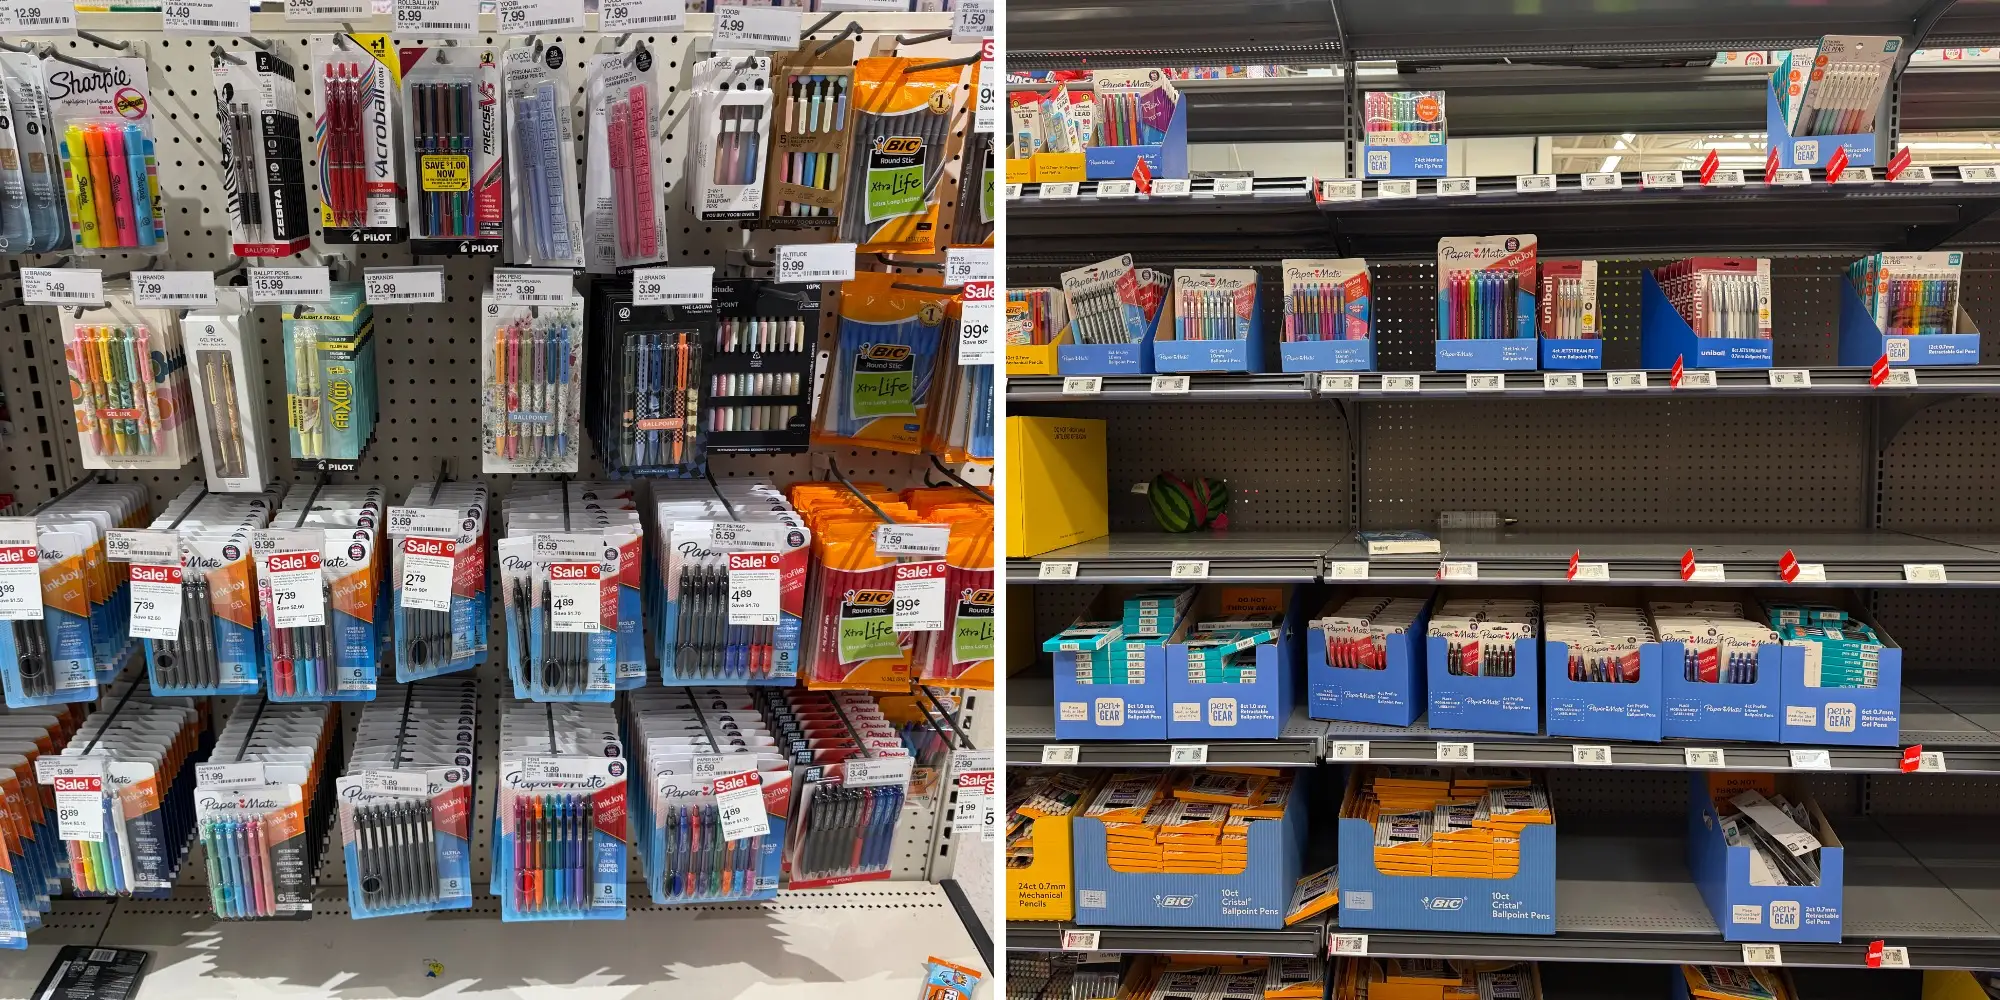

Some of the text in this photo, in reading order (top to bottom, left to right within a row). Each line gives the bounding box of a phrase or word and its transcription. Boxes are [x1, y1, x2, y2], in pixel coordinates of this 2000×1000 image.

[15, 8, 41, 18] 12.99
[166, 6, 190, 18] 4.49
[502, 11, 525, 22] 7.99
[604, 8, 628, 19] 7.99
[962, 14, 985, 25] 1.59
[720, 20, 744, 32] 4.99
[371, 37, 385, 48] +1
[49, 66, 132, 100] Sharpie
[1099, 79, 1126, 89] Paper
[372, 88, 388, 178] Acroball
[483, 105, 491, 154] PRECISE
[901, 156, 915, 164] Stic
[1369, 153, 1388, 162] pen+
[1797, 151, 1814, 160] GEAR
[425, 161, 466, 170] SAVE $1.00
[1372, 161, 1387, 170] GEAR
[436, 170, 456, 178] NOW
[892, 172, 922, 195] Life
[276, 188, 287, 236] ZEBRA
[364, 234, 392, 242] PILOT
[244, 246, 280, 255] BALLPOINT
[471, 244, 499, 252] PILOT
[1442, 246, 1506, 260] Paper Mate
[1508, 250, 1534, 267] InkJoy
[782, 261, 804, 271] 9.99
[950, 266, 970, 275] 1.59
[1065, 269, 1123, 289] Paper Mate
[1287, 268, 1342, 280] Paper Mate
[46, 283, 65, 291] 5.49
[256, 280, 284, 290] 15.99
[1178, 275, 1242, 289] Paper Mate
[138, 284, 161, 294] 7.99
[369, 284, 396, 294] 12.99
[516, 286, 535, 294] 3.99
[639, 284, 661, 294] 3.99
[1544, 276, 1552, 324] uniball
[1694, 272, 1702, 318] uniball
[1890, 349, 1906, 357] GEAR
[879, 376, 910, 397] Life
[513, 414, 549, 422] BALLPOINT
[392, 518, 411, 526] 3.69
[716, 532, 735, 540] 6.59
[883, 536, 901, 544] 1.59
[109, 541, 129, 550] 9.99
[255, 541, 275, 549] 9.99
[406, 540, 442, 554] Sale!
[186, 557, 222, 568] Mate
[270, 556, 307, 570] Sale!
[731, 556, 766, 568] Sale!
[132, 568, 168, 581] Sale!
[553, 566, 587, 578] Sale!
[897, 567, 932, 579] Sale!
[44, 568, 84, 592] InkJoy
[212, 580, 245, 598] InkJoy
[335, 579, 368, 598] InkJoy
[64, 590, 80, 601] GEL
[231, 601, 246, 610] GEL
[865, 621, 893, 640] Life
[1324, 624, 1369, 634] Paper Mate
[1430, 628, 1454, 638] Paper
[1480, 630, 1505, 640] Paper
[1662, 633, 1718, 645] Paper Mate
[1725, 637, 1750, 648] Paper
[70, 661, 80, 670] 3
[1699, 655, 1716, 665] Profile
[234, 664, 243, 673] 6
[1097, 703, 1121, 713] pen+
[1211, 703, 1234, 713] pen+
[1827, 707, 1852, 718] pen+
[1100, 710, 1120, 721] GEAR
[1213, 710, 1233, 721] GEAR
[1830, 716, 1850, 727] GEAR
[872, 740, 900, 748] Pentel
[697, 764, 715, 772] 6.59
[56, 779, 89, 790] Sale!
[716, 775, 748, 792] Sale!
[661, 785, 702, 799] Paper
[200, 797, 278, 810] Paper Mate
[437, 798, 462, 812] InkJoy
[598, 795, 624, 809] InkJoy
[270, 810, 298, 826] InkJoy
[283, 826, 298, 836] GEL
[1018, 882, 1036, 890] 24ct
[1222, 889, 1238, 897] 10ct
[1492, 892, 1510, 900] 10ct
[1019, 900, 1046, 908] Pencils
[1222, 907, 1279, 916] Ballpoint Pens
[1492, 911, 1550, 920] Ballpoint Pens
[1772, 904, 1797, 916] pen+
[1774, 914, 1795, 925] GEAR
